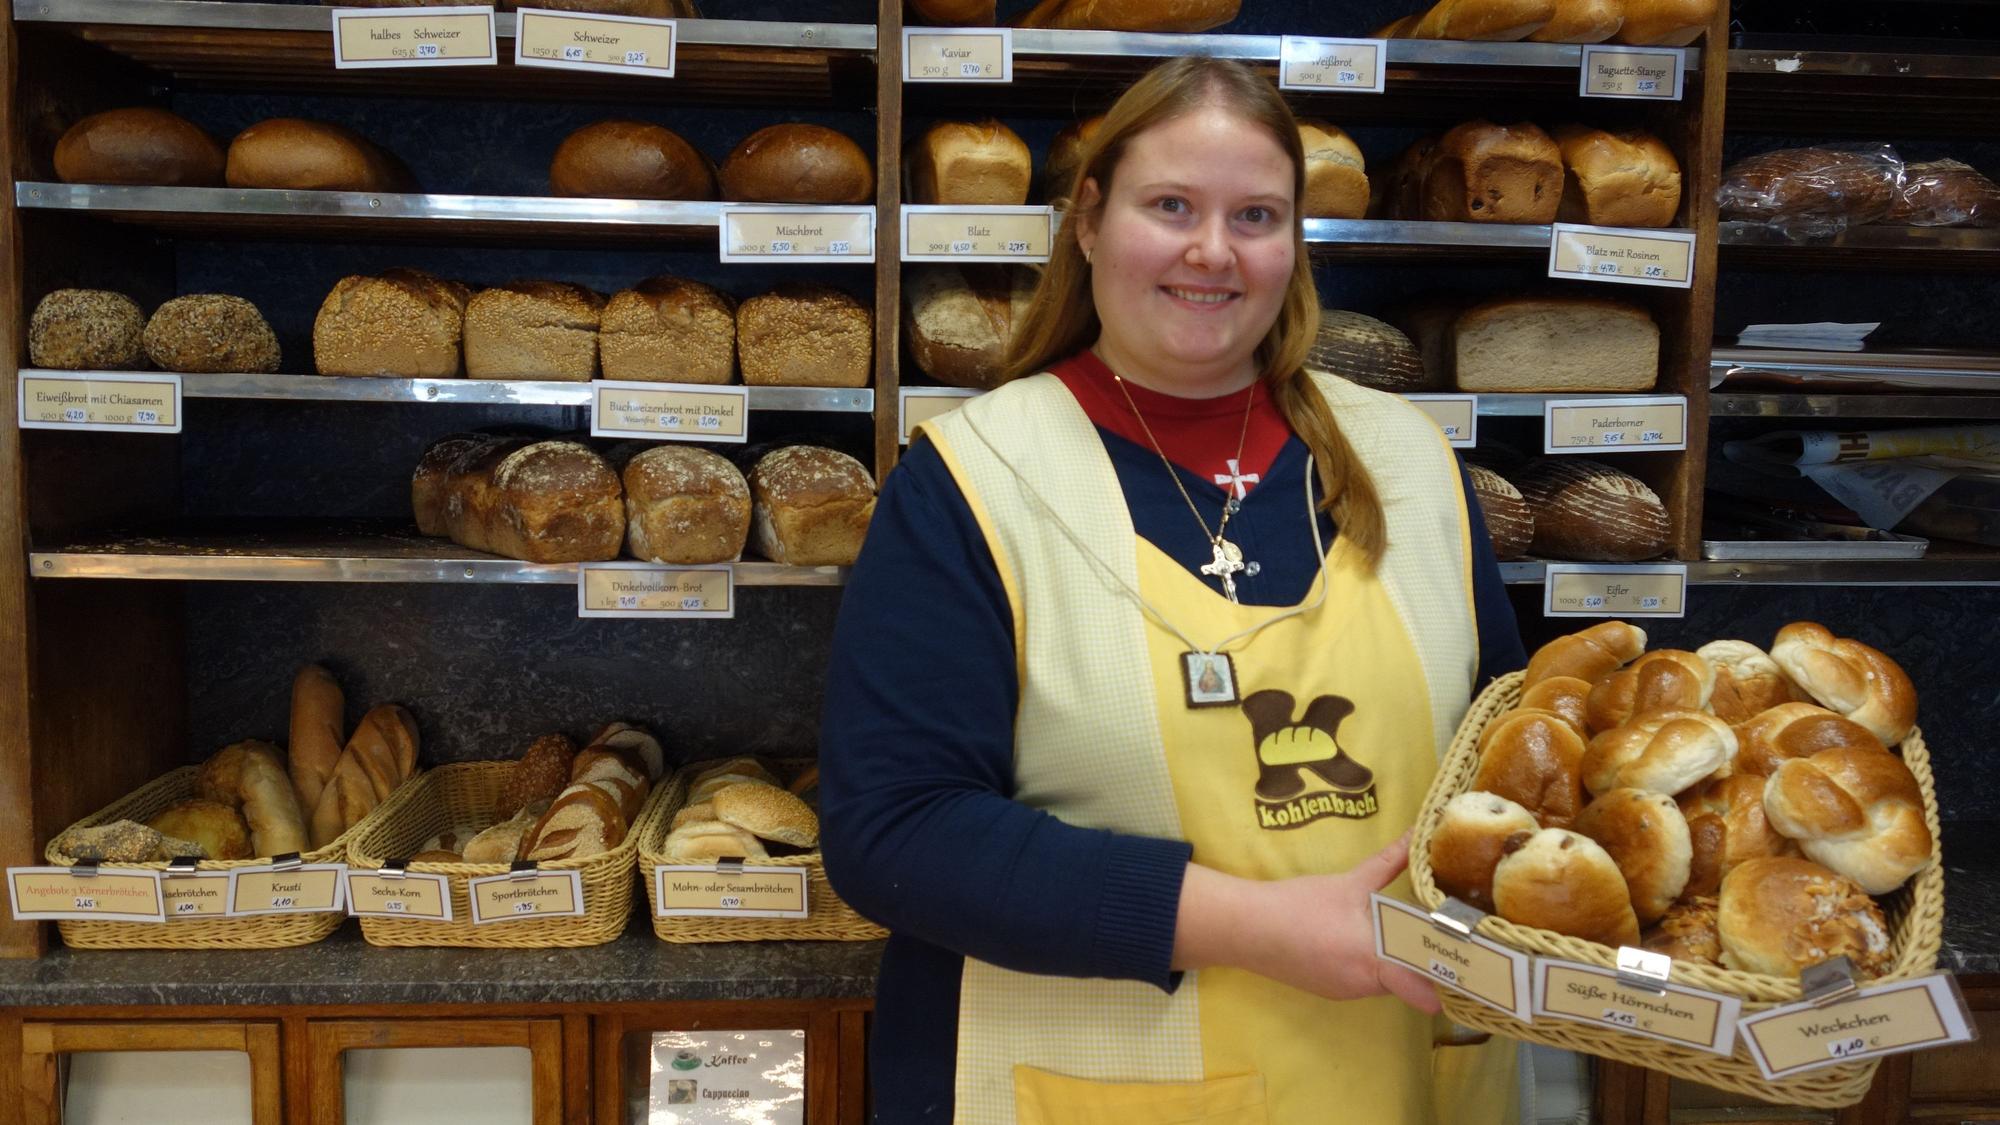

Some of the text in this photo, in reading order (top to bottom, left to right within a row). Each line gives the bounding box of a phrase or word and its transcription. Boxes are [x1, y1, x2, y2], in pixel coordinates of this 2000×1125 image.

[370, 27, 461, 41] halbes Schweizer
[573, 31, 621, 45] Schweizer
[392, 45, 447, 58] 625 g 3,70 €
[532, 47, 551, 57] 1250
[551, 49, 558, 58] g
[585, 50, 593, 59] €
[627, 52, 645, 64] 3,25
[941, 47, 972, 58] Kaviar
[922, 66, 940, 76] 500
[942, 66, 949, 76] g
[984, 64, 993, 74] €
[1598, 64, 1667, 80] Baguette-Stange
[1298, 72, 1315, 81] 500
[1316, 73, 1323, 83] g
[1357, 73, 1365, 82] €
[1616, 81, 1623, 91] g
[776, 224, 823, 236] Mischbrot
[967, 225, 991, 237] Blatz
[759, 244, 766, 253] g
[771, 241, 790, 253] 5,50
[791, 243, 799, 252] €
[831, 243, 849, 253] 3,25
[928, 243, 945, 252] 500
[944, 244, 950, 253] g
[953, 242, 970, 252] 4,50
[972, 242, 978, 251] €
[1008, 242, 1025, 252] 2,75
[1025, 242, 1032, 251] €
[1586, 245, 1661, 261] Blatz mit Rosinen
[36, 391, 163, 406] Eiweißbrot mit Chiasamen
[609, 401, 734, 417] Buchweizenbrot mit Dinkel
[40, 413, 57, 422] 500
[58, 414, 64, 422] g
[65, 410, 84, 421] 4,20
[88, 412, 95, 421] €
[105, 414, 125, 423] 1000
[126, 415, 133, 424] g
[158, 414, 165, 423] €
[1592, 417, 1645, 428] Paderborner
[1588, 435, 1595, 445] g
[1606, 585, 1629, 597] Eifler
[640, 599, 647, 607] €
[659, 600, 676, 609] 500
[702, 598, 710, 607] €
[1578, 598, 1584, 607] g
[1603, 597, 1610, 605] €
[1661, 597, 1668, 605] €
[1258, 792, 1377, 827] kohlenbach
[79, 885, 149, 897] Körnerbrötchen
[271, 882, 302, 893] Krusti
[371, 886, 421, 898] Sechs-Korn
[672, 881, 794, 894] Mohn- oder Sesambrötchen
[491, 886, 559, 902] Sportbrötchen
[177, 903, 204, 912] 1,00 €
[272, 897, 299, 907] 1,10 €
[535, 903, 542, 911] €
[740, 898, 747, 906] €
[1421, 935, 1471, 968] Brioche
[1456, 975, 1465, 986] €
[1566, 981, 1696, 1021] Süße Hörnchen
[1642, 1020, 1654, 1029] €
[1798, 1012, 1891, 1039] Weckchen
[1833, 1035, 1881, 1057] 1,10 €
[704, 1055, 749, 1068] Kaffee
[702, 1087, 750, 1100] Cappuccino
